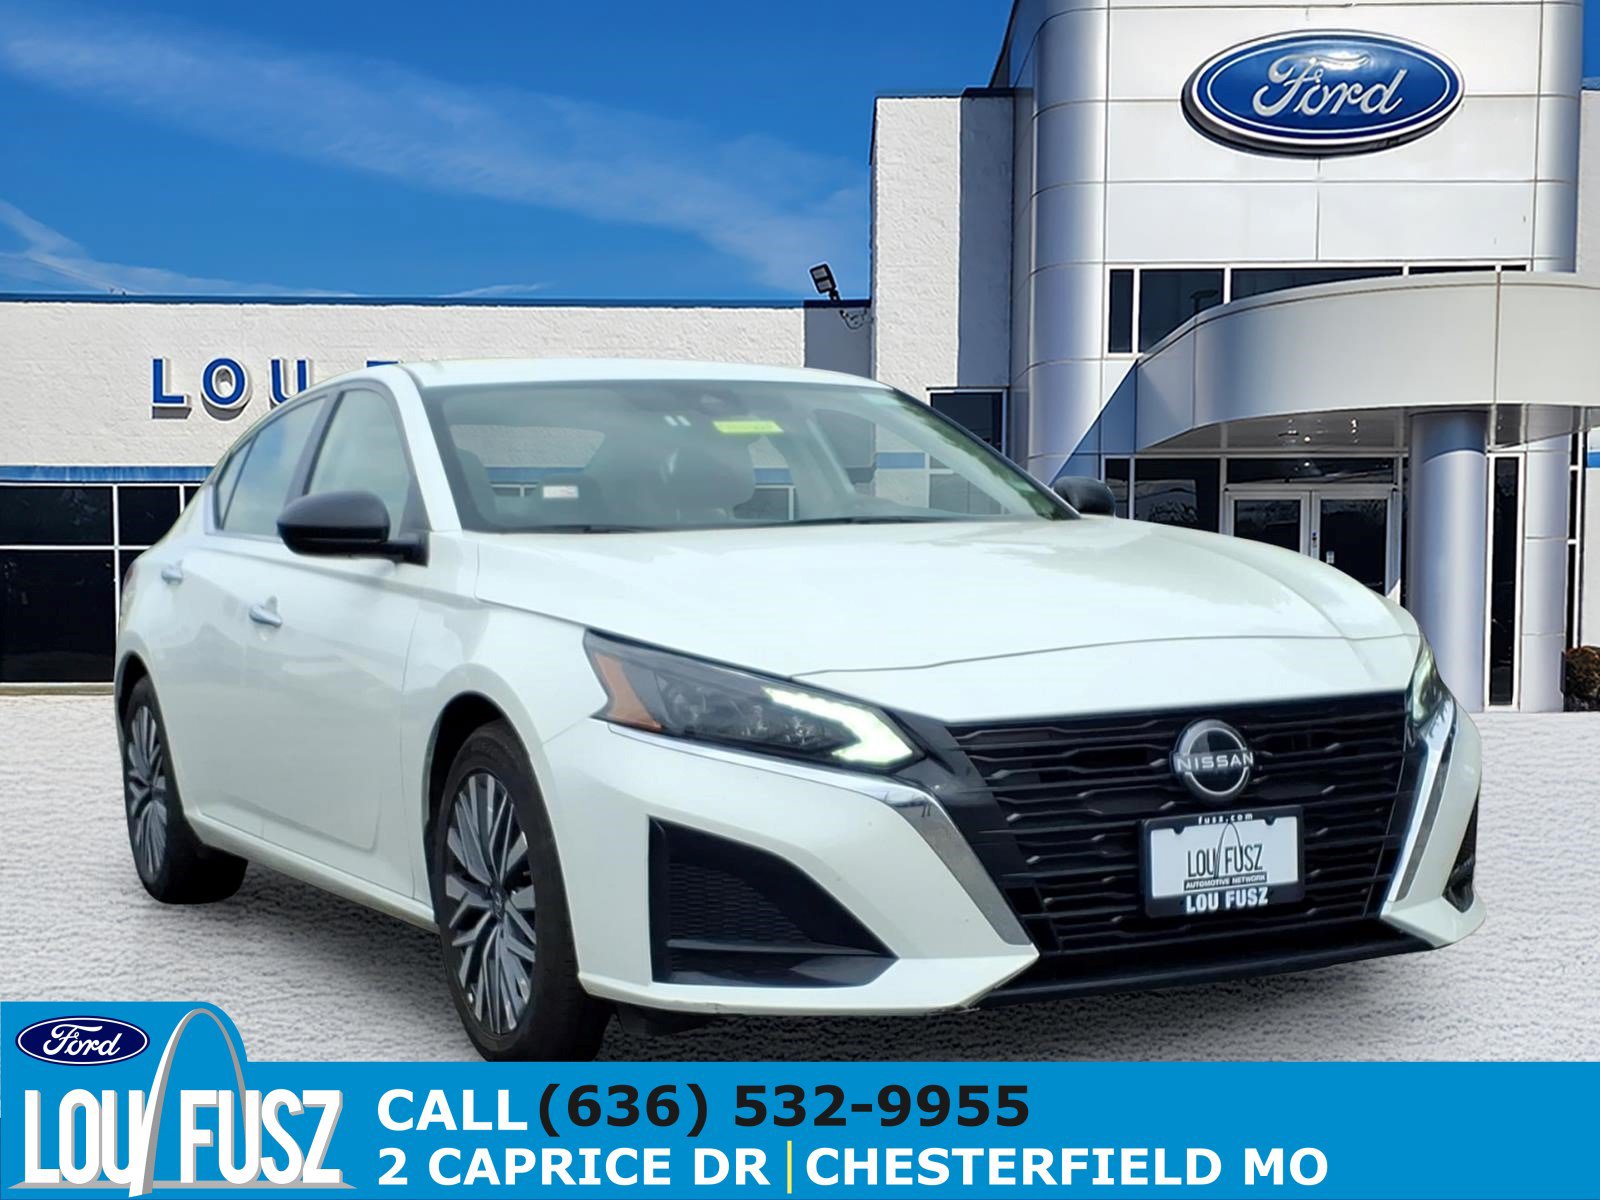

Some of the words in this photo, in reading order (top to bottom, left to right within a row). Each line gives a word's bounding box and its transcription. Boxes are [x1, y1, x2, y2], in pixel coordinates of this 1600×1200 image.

[1252, 54, 1408, 117] Ford
[152, 357, 311, 407] LOU
[1176, 752, 1254, 772] NISSAN
[1187, 849, 1216, 877] LOU
[1225, 844, 1264, 875] FUSZ
[1185, 878, 1230, 890] AUTOMOTIVE
[1231, 874, 1266, 885] NETWORK
[1186, 892, 1219, 914] LOU
[1225, 887, 1269, 909] FUSZ
